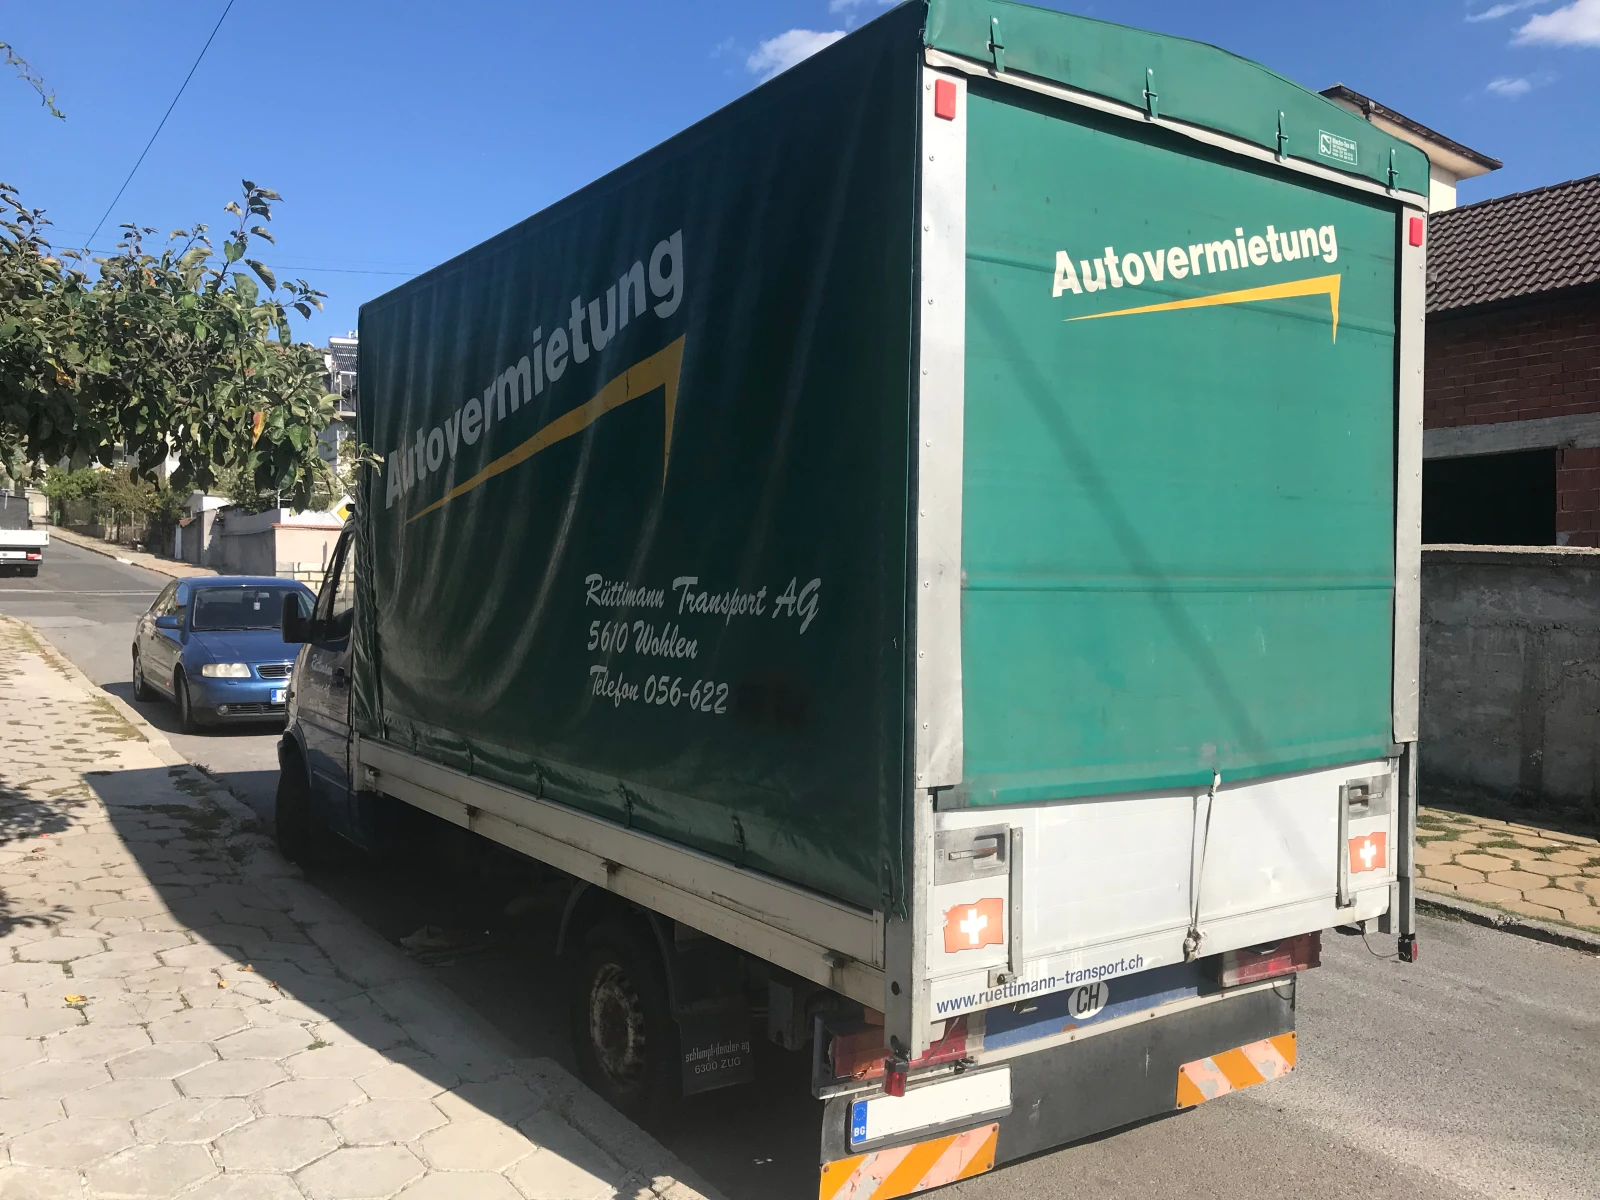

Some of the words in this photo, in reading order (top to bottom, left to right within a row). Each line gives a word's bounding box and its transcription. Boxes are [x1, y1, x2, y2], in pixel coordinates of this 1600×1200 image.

[1052, 224, 1338, 298] Autovermietung
[385, 229, 685, 510] Autovermietung
[584, 572, 665, 609] Rüttimann
[672, 575, 767, 626] Transport
[771, 576, 822, 635] AG
[587, 620, 629, 653] 5610
[632, 619, 698, 660] Wohlen
[589, 664, 640, 708] Telefon
[644, 674, 729, 715] 056-622
[936, 953, 1144, 1014] www.ruettimann-transport.ch
[1076, 983, 1101, 1014] CH
[694, 1061, 718, 1074] 6300
[720, 1056, 741, 1069] ZUG
[741, 1041, 750, 1053] ag
[853, 1125, 866, 1137] BG
